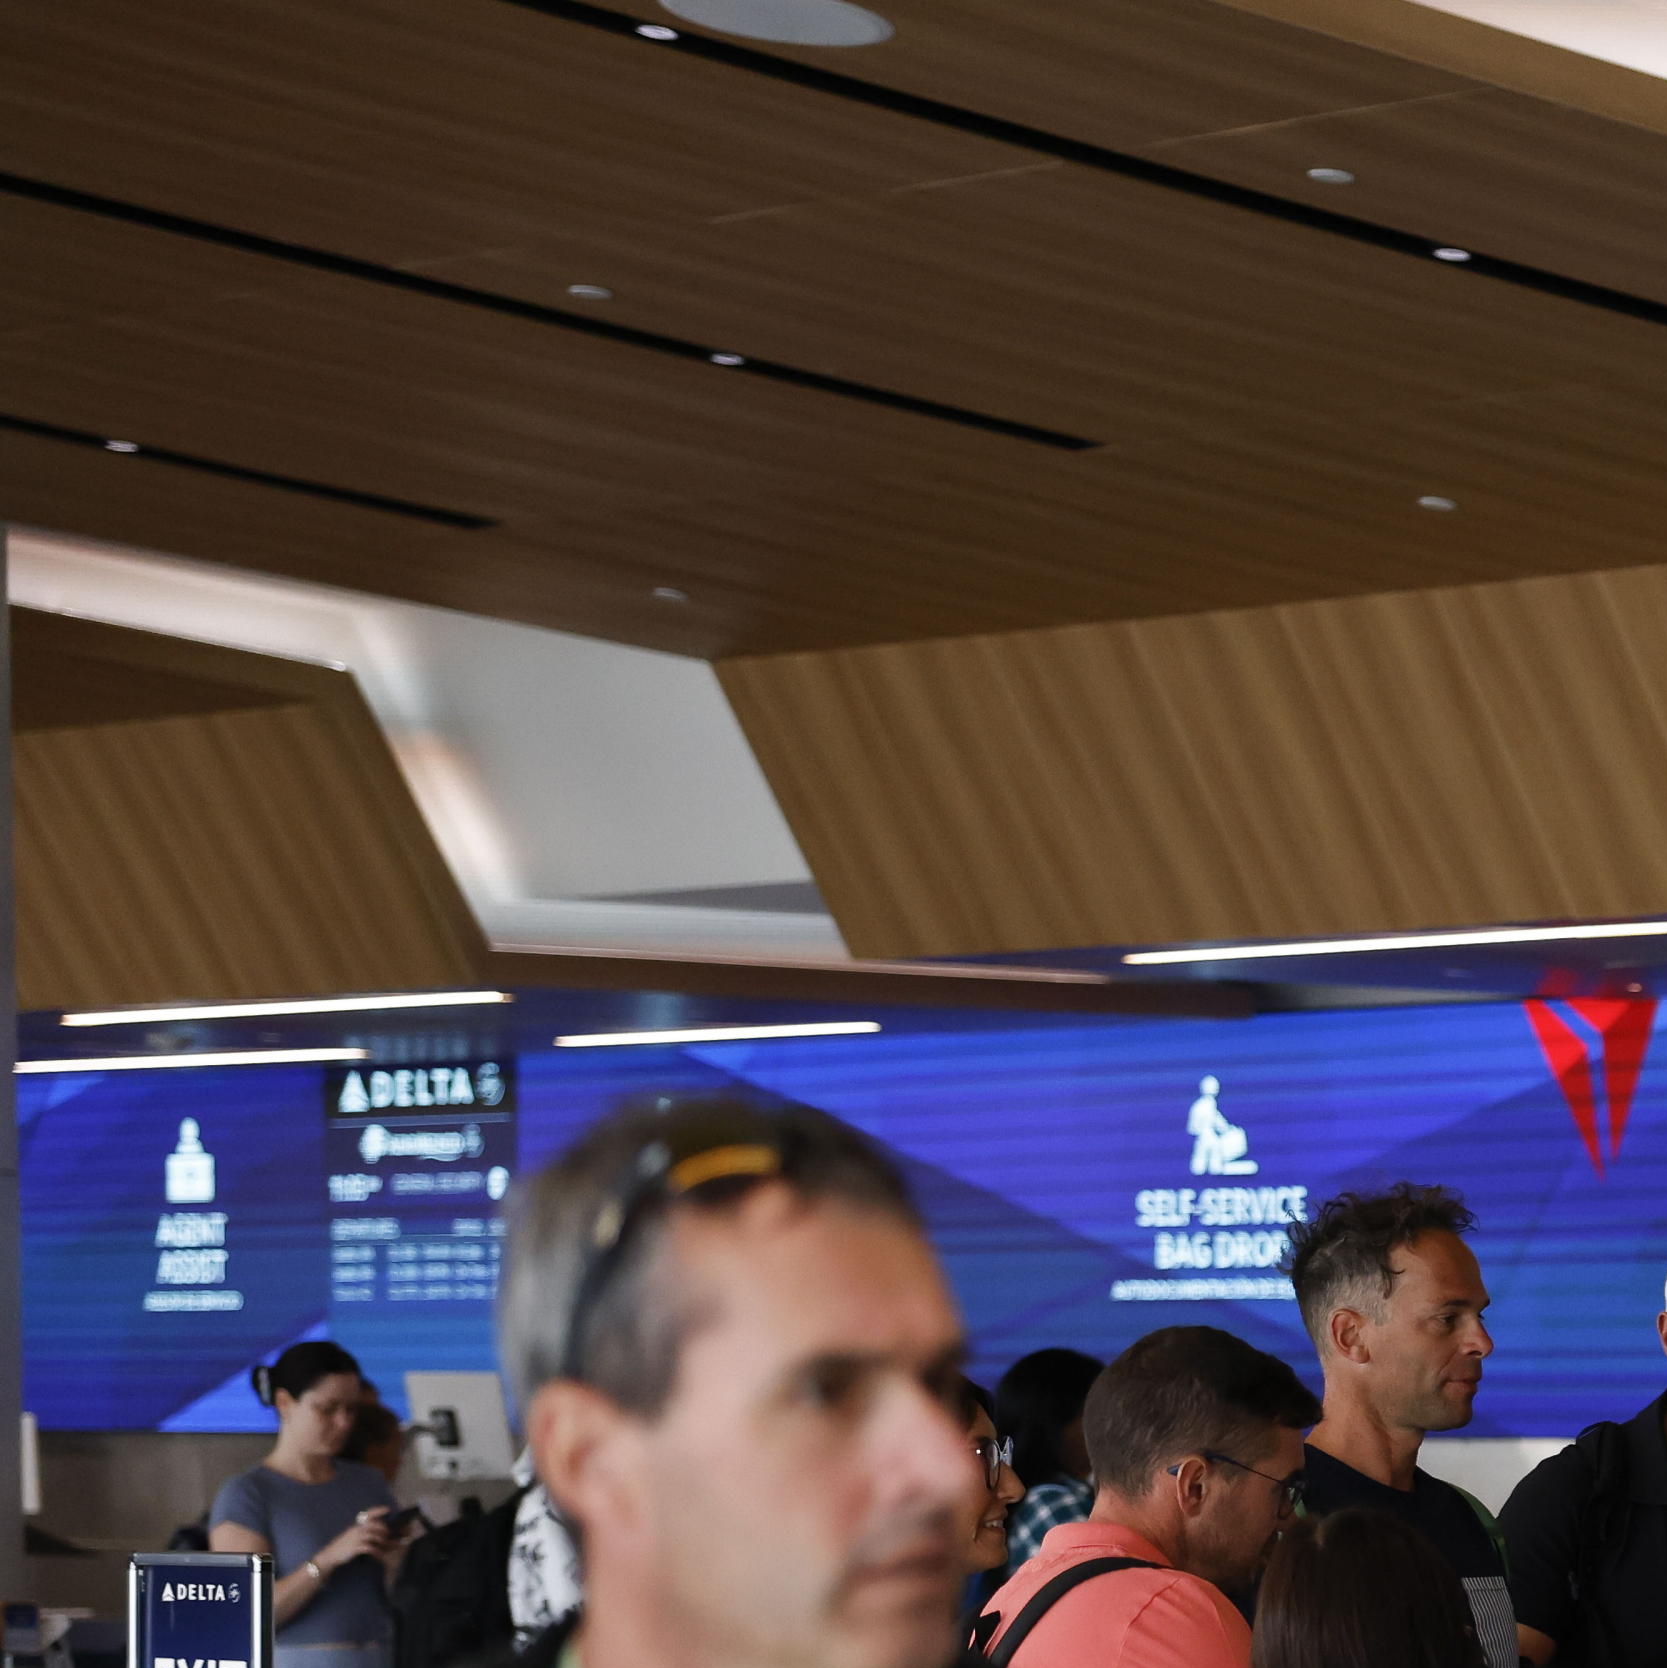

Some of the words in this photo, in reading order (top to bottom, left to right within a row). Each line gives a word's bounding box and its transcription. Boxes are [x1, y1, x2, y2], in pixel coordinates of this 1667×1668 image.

[369, 1067, 475, 1108] DELTA
[1135, 1185, 1308, 1227] SELF-SERVICE
[1154, 1231, 1212, 1270] BAG
[177, 1583, 226, 1601] DELTA
